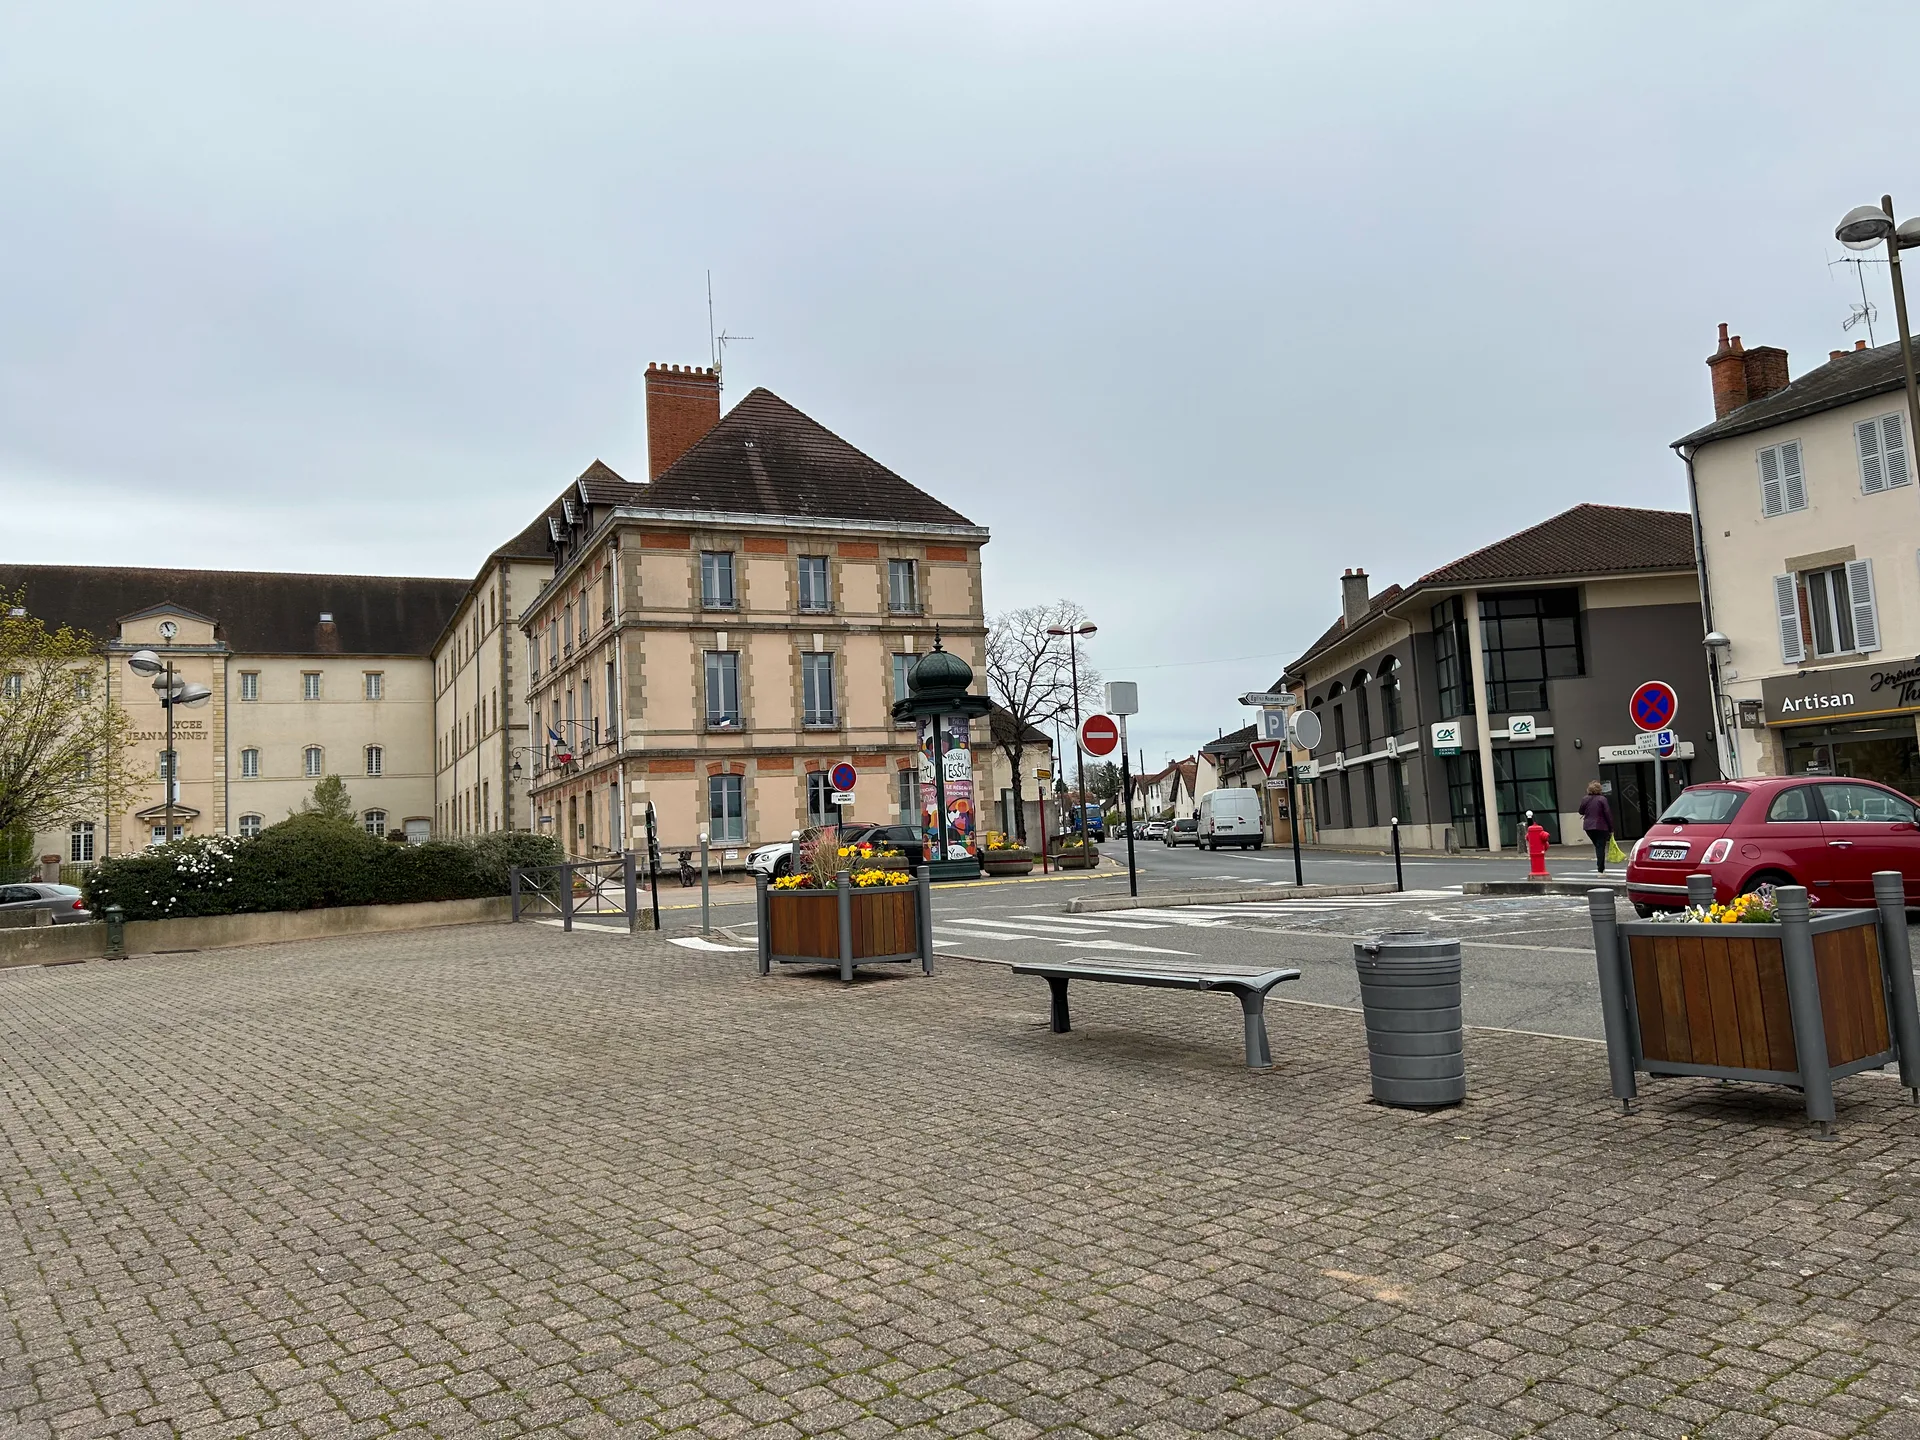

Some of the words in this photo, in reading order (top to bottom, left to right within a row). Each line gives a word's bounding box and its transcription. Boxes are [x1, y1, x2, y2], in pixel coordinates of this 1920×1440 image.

[1781, 692, 1855, 713] Artisan
[1268, 715, 1280, 735] P
[127, 731, 157, 741] JEAN
